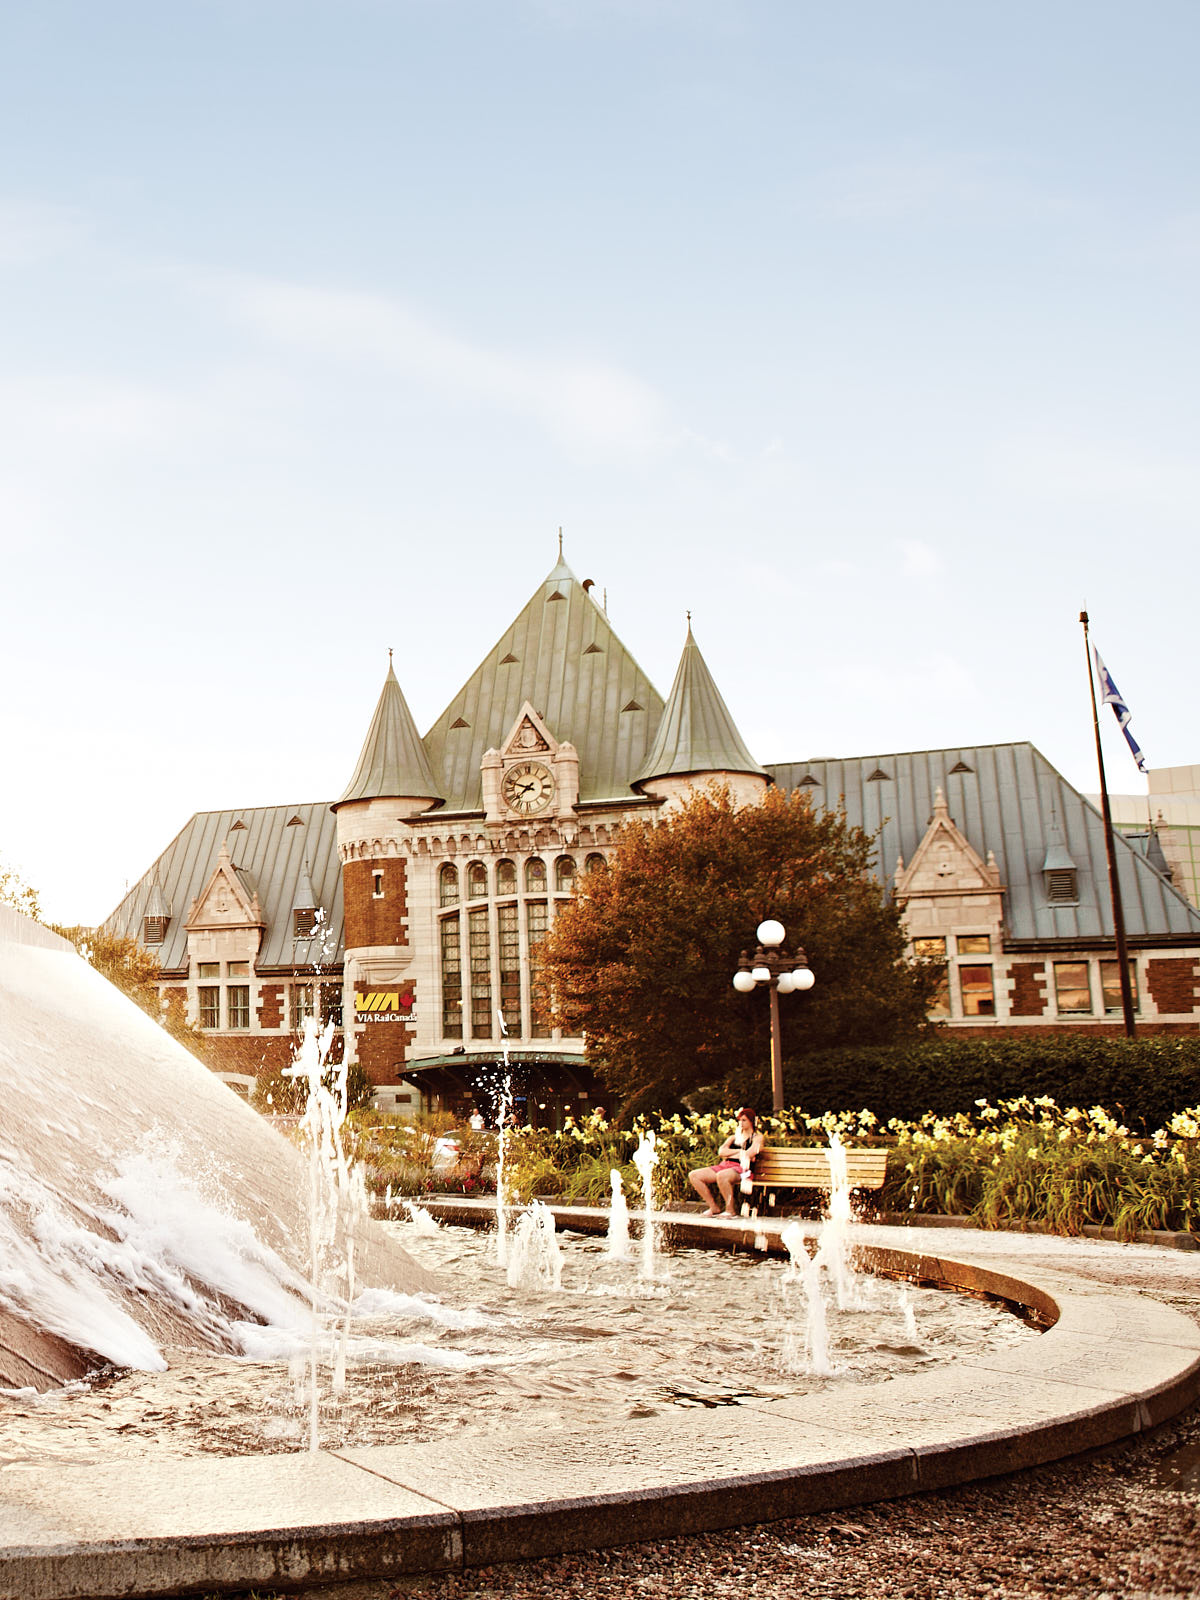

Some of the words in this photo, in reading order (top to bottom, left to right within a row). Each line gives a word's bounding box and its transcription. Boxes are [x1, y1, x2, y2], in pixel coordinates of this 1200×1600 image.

[356, 993, 399, 1011] VIA
[357, 1013, 373, 1022] VIA
[374, 1013, 389, 1022] Rail
[390, 1012, 417, 1022] Canada
